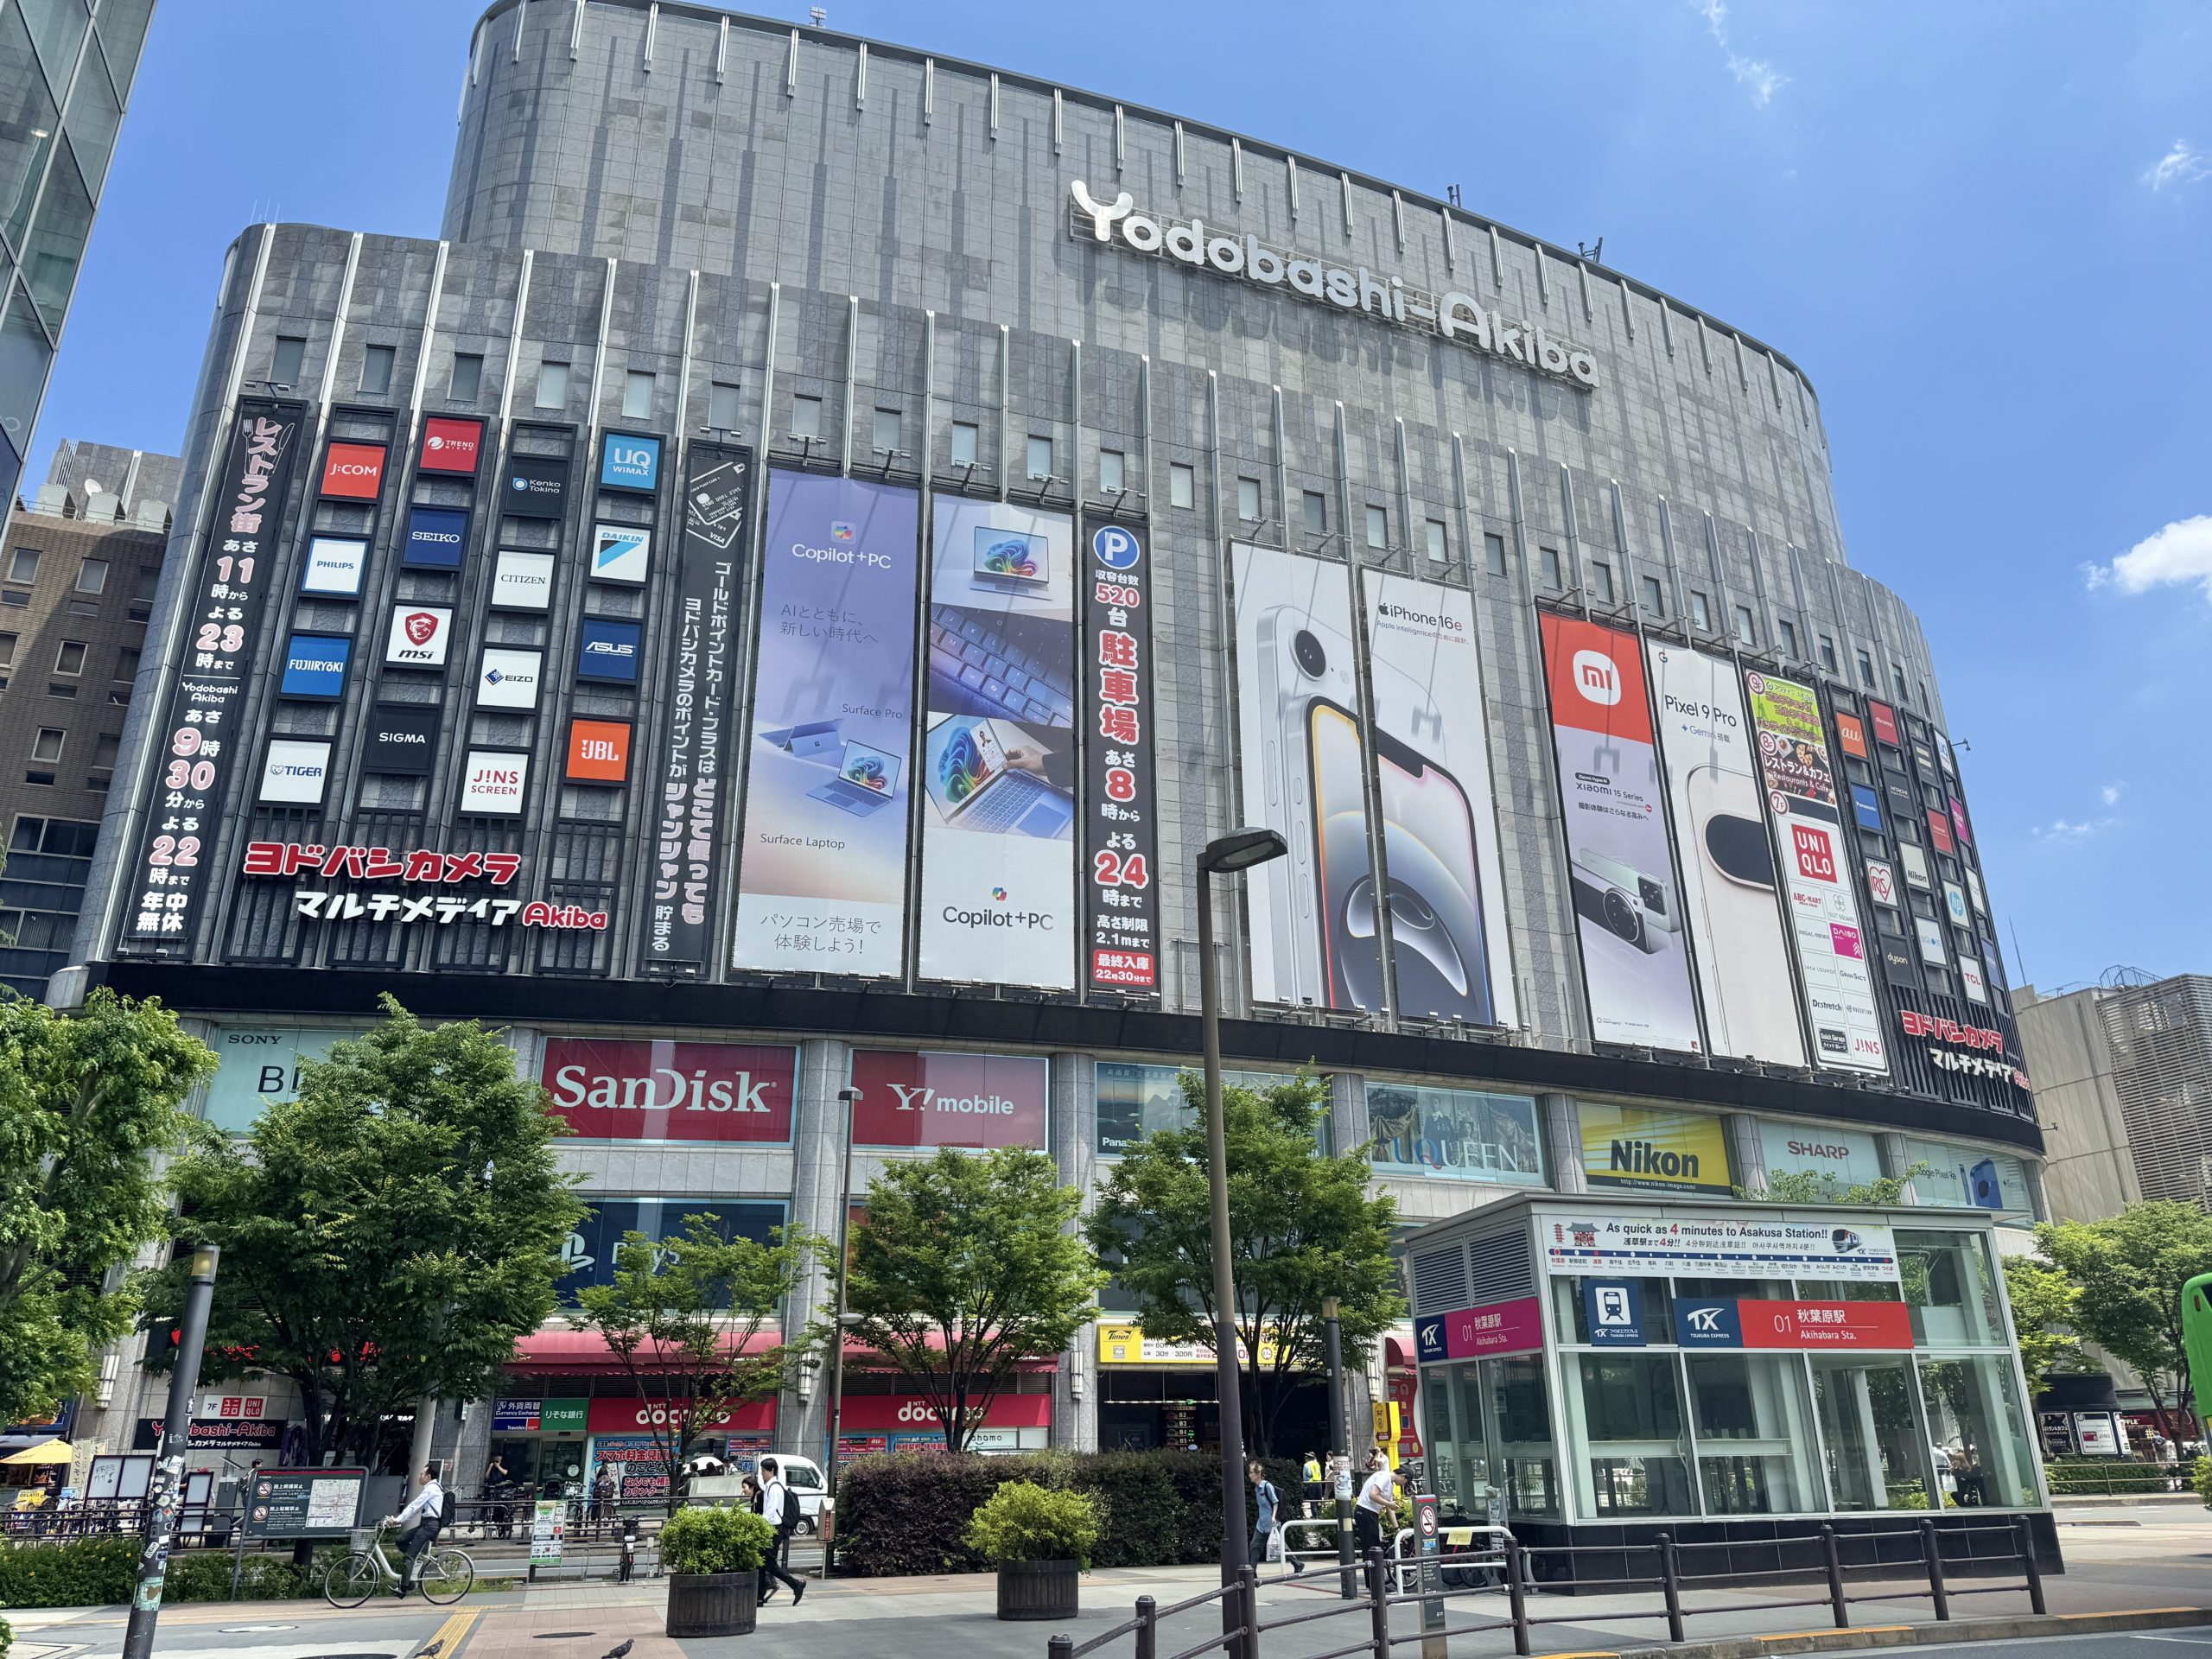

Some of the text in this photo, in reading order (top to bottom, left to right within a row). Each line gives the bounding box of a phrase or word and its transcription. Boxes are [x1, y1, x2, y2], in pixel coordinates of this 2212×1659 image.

[1071, 180, 1599, 388] Yodobashi-Akiba
[445, 440, 474, 449] TREND
[613, 447, 651, 467] UQ
[231, 417, 282, 534] レストラン街
[330, 463, 378, 476] J:COM
[613, 464, 649, 476] WiMAX
[529, 479, 561, 488] Kenko
[411, 531, 460, 543] SEIKO
[601, 531, 644, 543] DAIKIN
[709, 532, 726, 543] VISA
[222, 539, 258, 553] あさ
[1104, 531, 1128, 561] P
[217, 556, 255, 583] 11
[316, 560, 354, 569] PHILIPS
[501, 574, 546, 585] CITIZEN
[1095, 569, 1139, 587] 収容台数
[211, 584, 248, 601] 時から
[1095, 582, 1140, 608] 520
[207, 606, 244, 620] よる
[1107, 607, 1128, 627] 台
[1389, 605, 1463, 631] iPhone 16e
[779, 621, 878, 644] 新しい時代へ
[1376, 620, 1395, 630] Apple
[196, 623, 245, 652] 23
[398, 650, 435, 660] msi
[585, 641, 636, 653] ASUS
[195, 653, 234, 670] 時まで
[505, 674, 533, 683] EIZO
[1751, 677, 1763, 691] 9F
[182, 682, 238, 695] Yodobashi
[1098, 629, 1140, 747] 駐車場
[191, 693, 226, 703] Akiba
[184, 709, 222, 723] あさ
[842, 703, 903, 719] Surface Pro
[1664, 695, 1737, 728] Pixel 9 Pro
[378, 732, 426, 744] SIGMA
[1762, 735, 1773, 750] 8F
[1841, 727, 1862, 742] au
[582, 740, 620, 761] JBL
[1104, 748, 1135, 768] あさ
[165, 760, 215, 790] 30
[284, 766, 322, 777] TIGER
[652, 598, 701, 951] ヨドバシカメラのポイントが ジャンジャン 貯まる
[471, 785, 518, 795] SCREEN
[1105, 766, 1136, 802] 8
[164, 791, 205, 810] 分から
[1613, 789, 1622, 798] 15
[1623, 791, 1643, 802] Series
[1773, 796, 1785, 810] 7F
[1101, 803, 1141, 822] 時から
[162, 817, 199, 831] よる
[760, 833, 845, 850] Surface Laptop
[1106, 831, 1137, 850] よる
[1796, 830, 1826, 854] UNI
[149, 835, 200, 866] 22
[682, 778, 717, 924] どこで使っても
[243, 842, 520, 885] ヨドバシカメラ
[1094, 849, 1149, 889] 24
[1801, 854, 1832, 875] QLO
[149, 868, 190, 886] 時まで
[1907, 869, 1927, 883] Nikon
[141, 892, 188, 912] 年中
[1103, 888, 1142, 908] 時まで
[1793, 893, 1821, 905] ABC-MART
[296, 891, 607, 929] マルチメディア Akiba
[136, 912, 183, 931] 無休
[760, 912, 882, 934] パソコン売場で
[1096, 914, 1149, 932] 高さ制限
[1096, 931, 1150, 949] 2.1mまで
[1834, 927, 1857, 939] DAISO
[1097, 954, 1150, 970] 最終入庫
[1887, 952, 1909, 965] dyson
[1096, 969, 1152, 983] 22時30分まで
[1965, 973, 1981, 986] TCL
[228, 1034, 283, 1045] SONY
[1901, 1010, 2003, 1054] ヨドバシカメラ
[1929, 1048, 2012, 1083] マルチメディア
[553, 1065, 772, 1113] SanDisk
[1611, 1140, 1699, 1178] Nikon
[1787, 1141, 1850, 1160] SHARP
[1620, 1178, 1696, 1191] http://www.nikon-image.com/
[1606, 1222, 1827, 1239] As quick as 4 minutes to Asakusa Station!!
[1462, 1313, 1502, 1341] 01 秋葉原駅
[1688, 1307, 1726, 1331] TX
[1774, 1309, 1846, 1333] 01 秋葉原駅
[1109, 1331, 1130, 1340] Times
[1477, 1333, 1508, 1346] Akihabara Sta.
[1801, 1329, 1857, 1339] Akihabara Sta.
[223, 1407, 238, 1415] クロ
[508, 1402, 541, 1410] 外貨両替
[545, 1410, 584, 1419] りそな銀行
